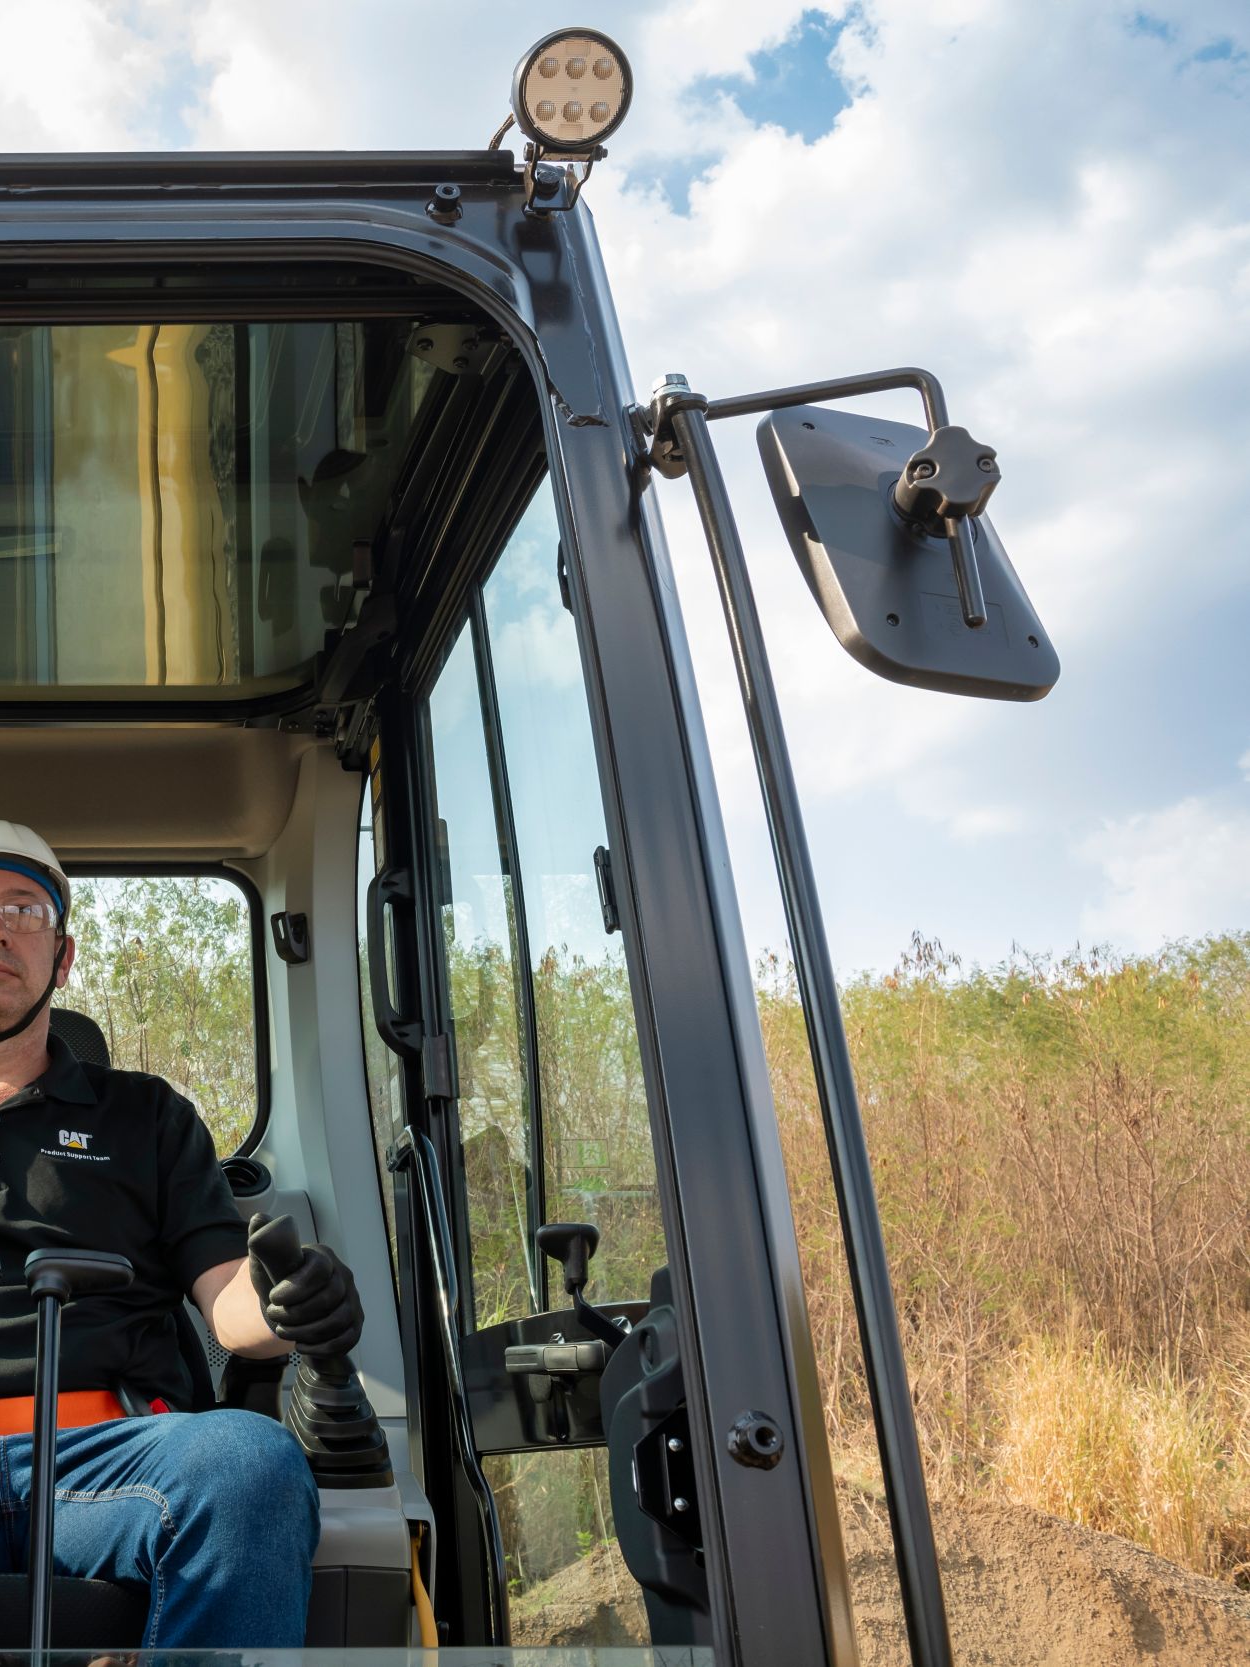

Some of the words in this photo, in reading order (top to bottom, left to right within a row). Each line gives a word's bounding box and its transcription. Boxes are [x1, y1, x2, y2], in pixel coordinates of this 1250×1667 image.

[58, 1129, 88, 1150] CAT
[40, 1148, 66, 1156] Product
[67, 1152, 92, 1160] Support
